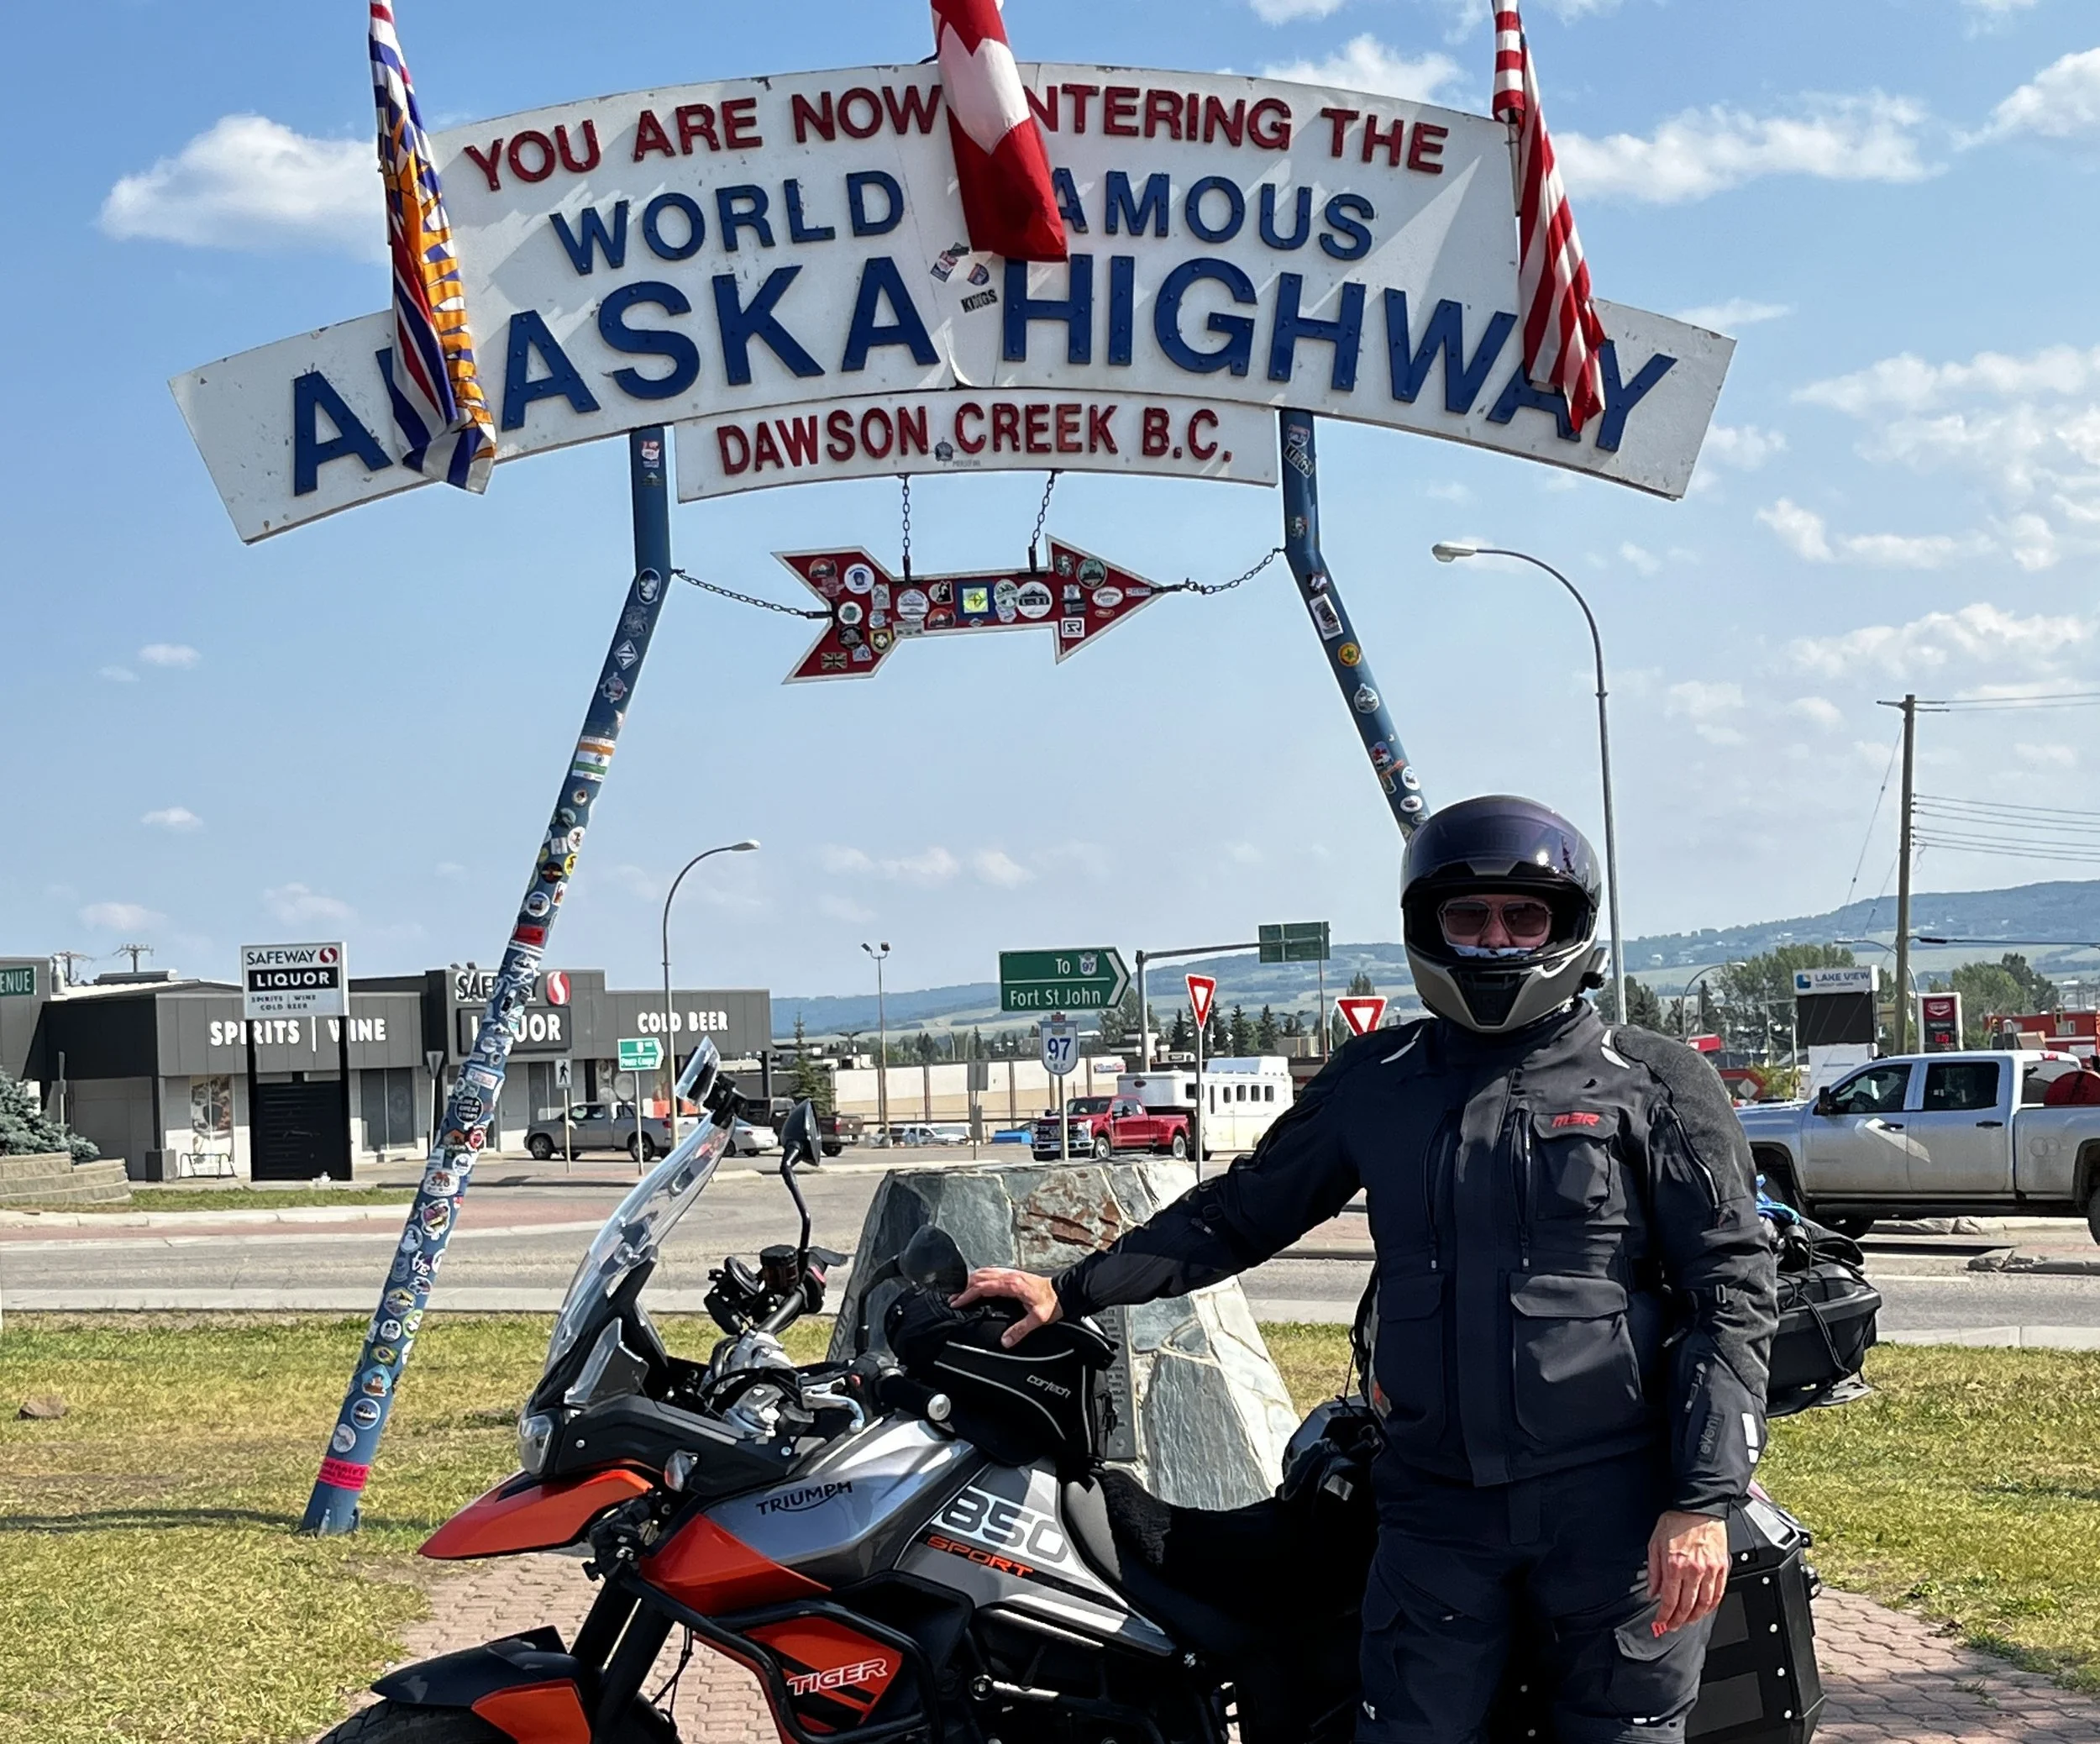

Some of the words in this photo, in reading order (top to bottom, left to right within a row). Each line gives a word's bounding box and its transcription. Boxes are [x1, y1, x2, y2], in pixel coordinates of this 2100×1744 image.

[464, 119, 601, 191] YOU
[633, 97, 762, 162] ARE
[791, 85, 942, 143] NOW
[1023, 83, 1292, 150] NTERING
[1320, 108, 1449, 173] THE
[549, 171, 904, 276] WORLD
[1052, 168, 1374, 260] AMOUS
[293, 256, 941, 497] AASKA
[1003, 254, 1677, 452] HIGHWAY
[717, 406, 928, 475] DAWSON
[954, 402, 1118, 453] CREEK
[1142, 407, 1232, 462] B.C.
[247, 950, 316, 965] SAFEWAY
[1055, 959, 1071, 975] To
[1082, 962, 1095, 972] 97
[256, 971, 329, 987] LIQUOR
[1814, 973, 1840, 982] LAKE
[1844, 971, 1870, 980] VIEW
[1011, 989, 1040, 1006] Fort
[1046, 989, 1060, 1006] St
[1065, 986, 1100, 1005] John
[638, 1012, 682, 1033] COLD
[689, 1011, 728, 1032] BEER
[1047, 1037, 1072, 1062] 97
[757, 1481, 853, 1515] TRIUMPH
[927, 1536, 1033, 1578] SPORT
[787, 1657, 888, 1696] TIGER
